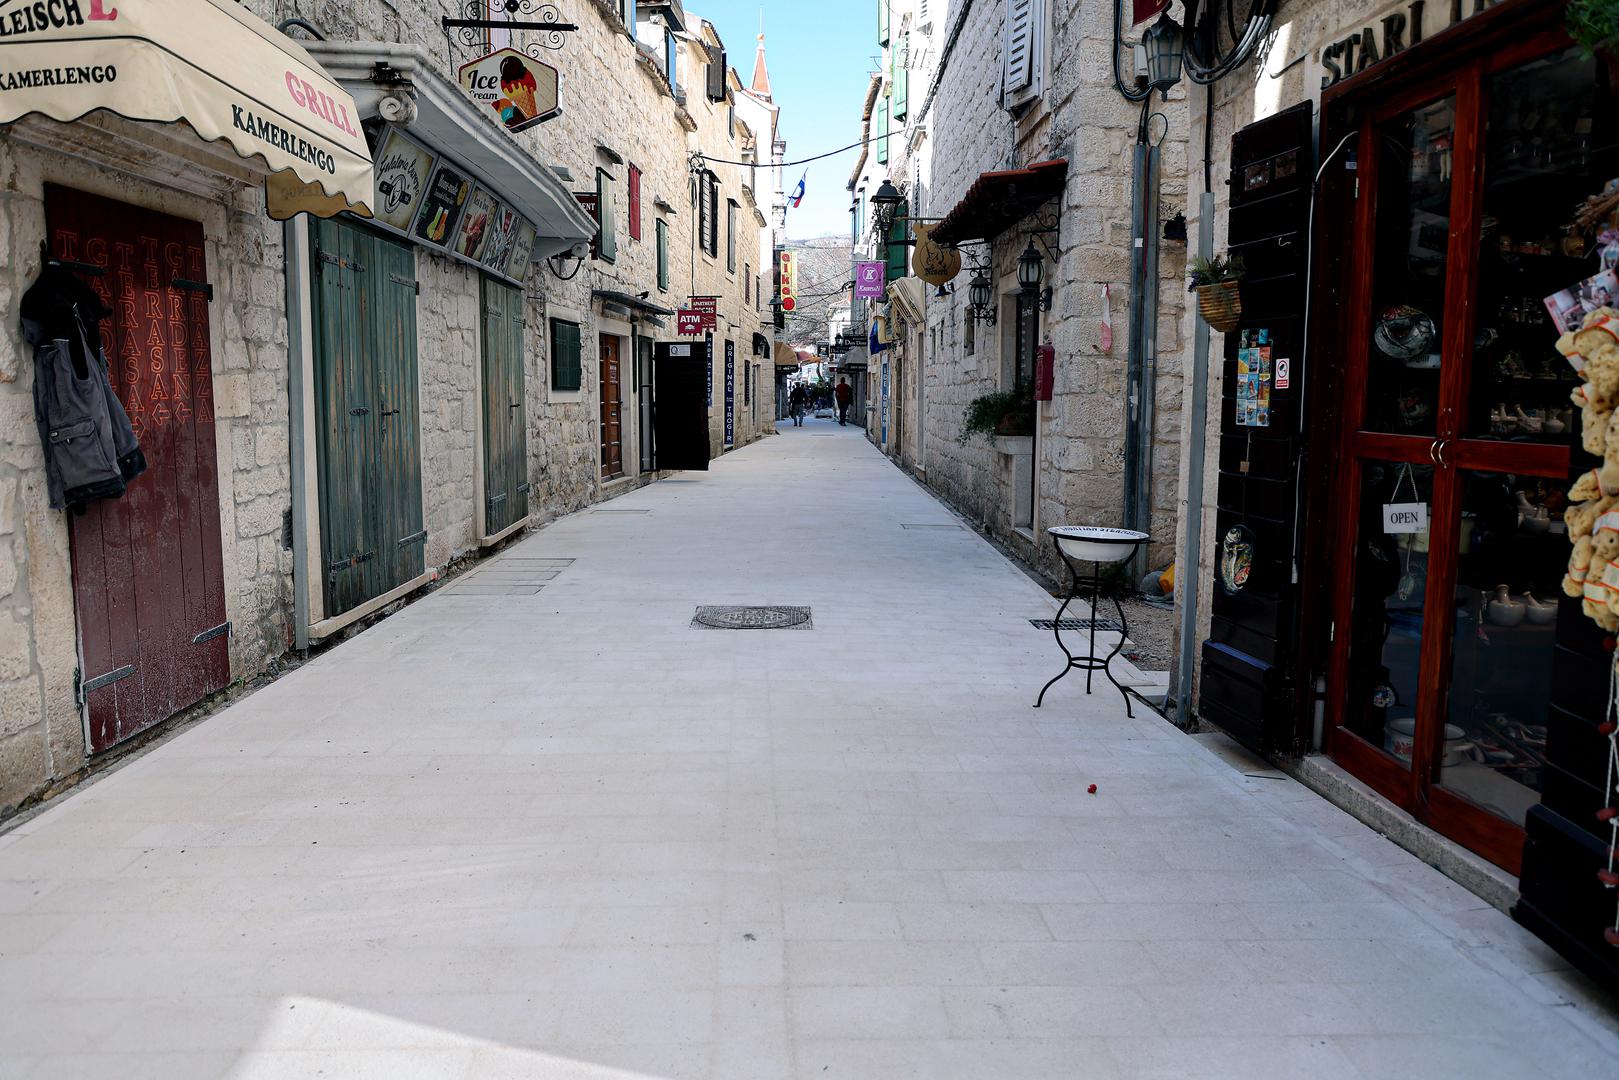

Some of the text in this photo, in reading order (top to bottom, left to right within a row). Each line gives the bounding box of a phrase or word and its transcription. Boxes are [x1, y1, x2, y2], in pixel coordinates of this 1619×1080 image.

[468, 70, 498, 89] Ice
[1320, 1, 1425, 90] STARI
[231, 104, 336, 175] KAMERLENGO
[285, 71, 357, 138] GRILL
[115, 242, 145, 412] TERASA
[141, 236, 169, 401] TERASA
[164, 243, 191, 400] GARDEN
[680, 315, 700, 323] ATM
[1390, 511, 1418, 524] OPEN
